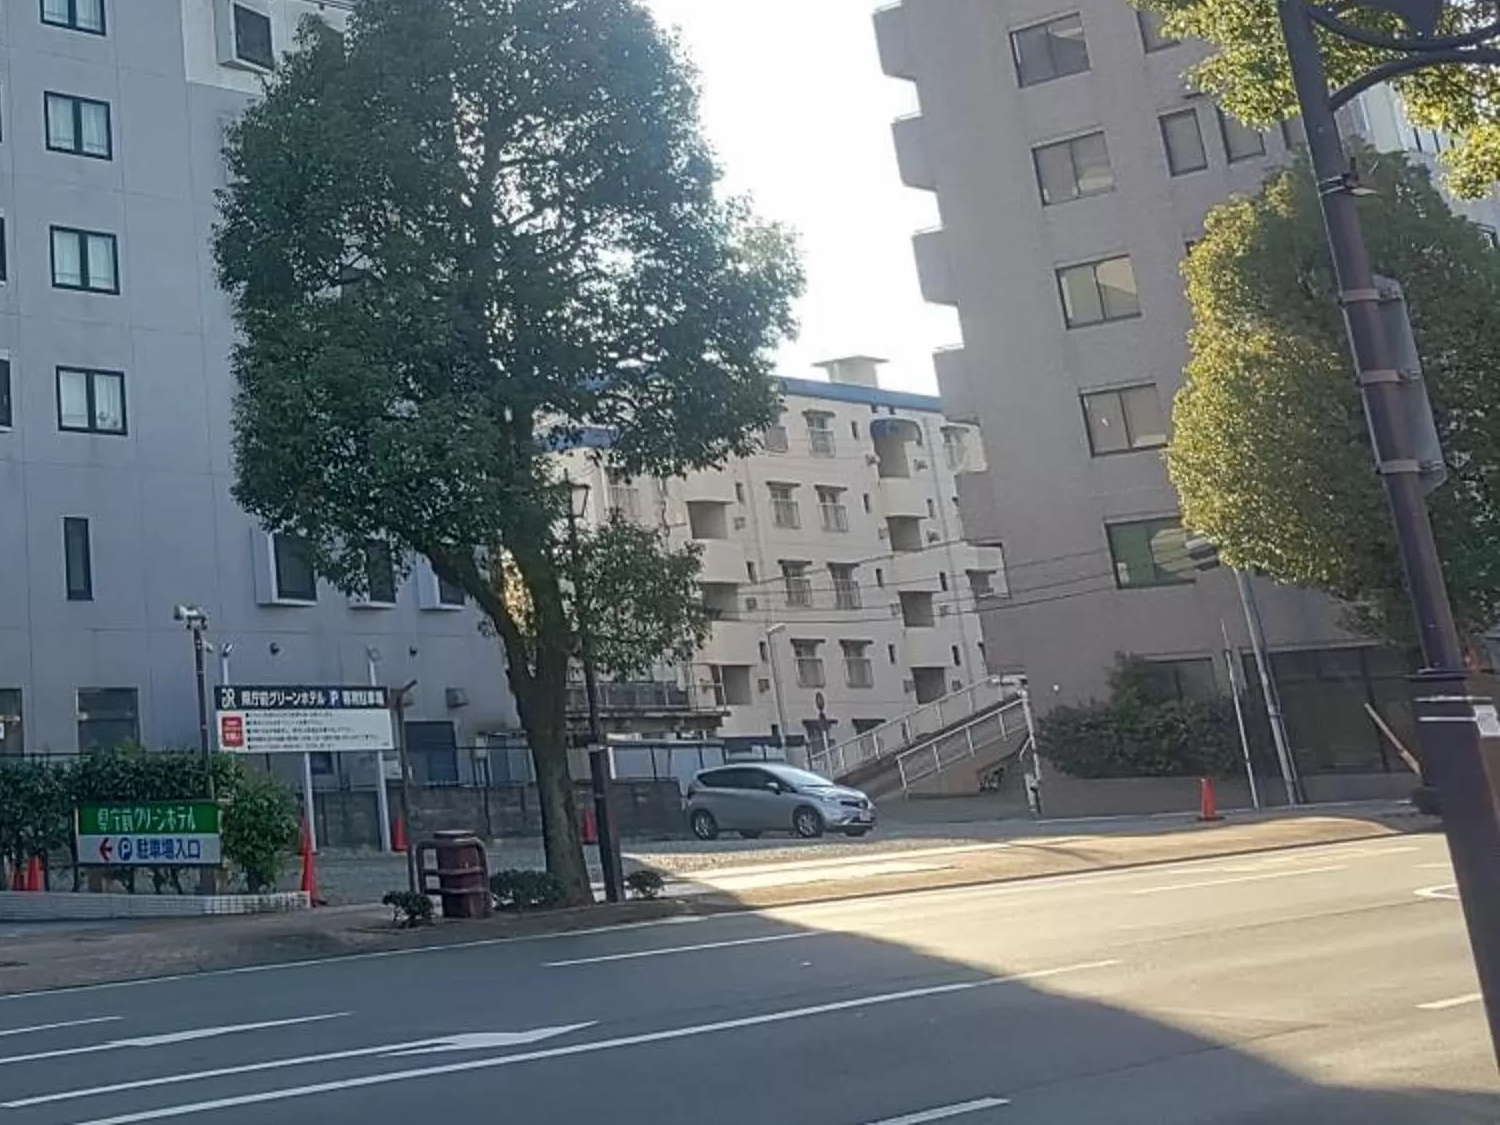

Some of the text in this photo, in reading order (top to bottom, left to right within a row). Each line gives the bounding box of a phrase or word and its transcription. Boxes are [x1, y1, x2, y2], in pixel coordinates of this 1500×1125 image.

[241, 690, 325, 707] 県庁前グリーンホテル
[97, 805, 197, 832] 県庁前グリーンホテル
[136, 838, 201, 860] 駐車場入口
